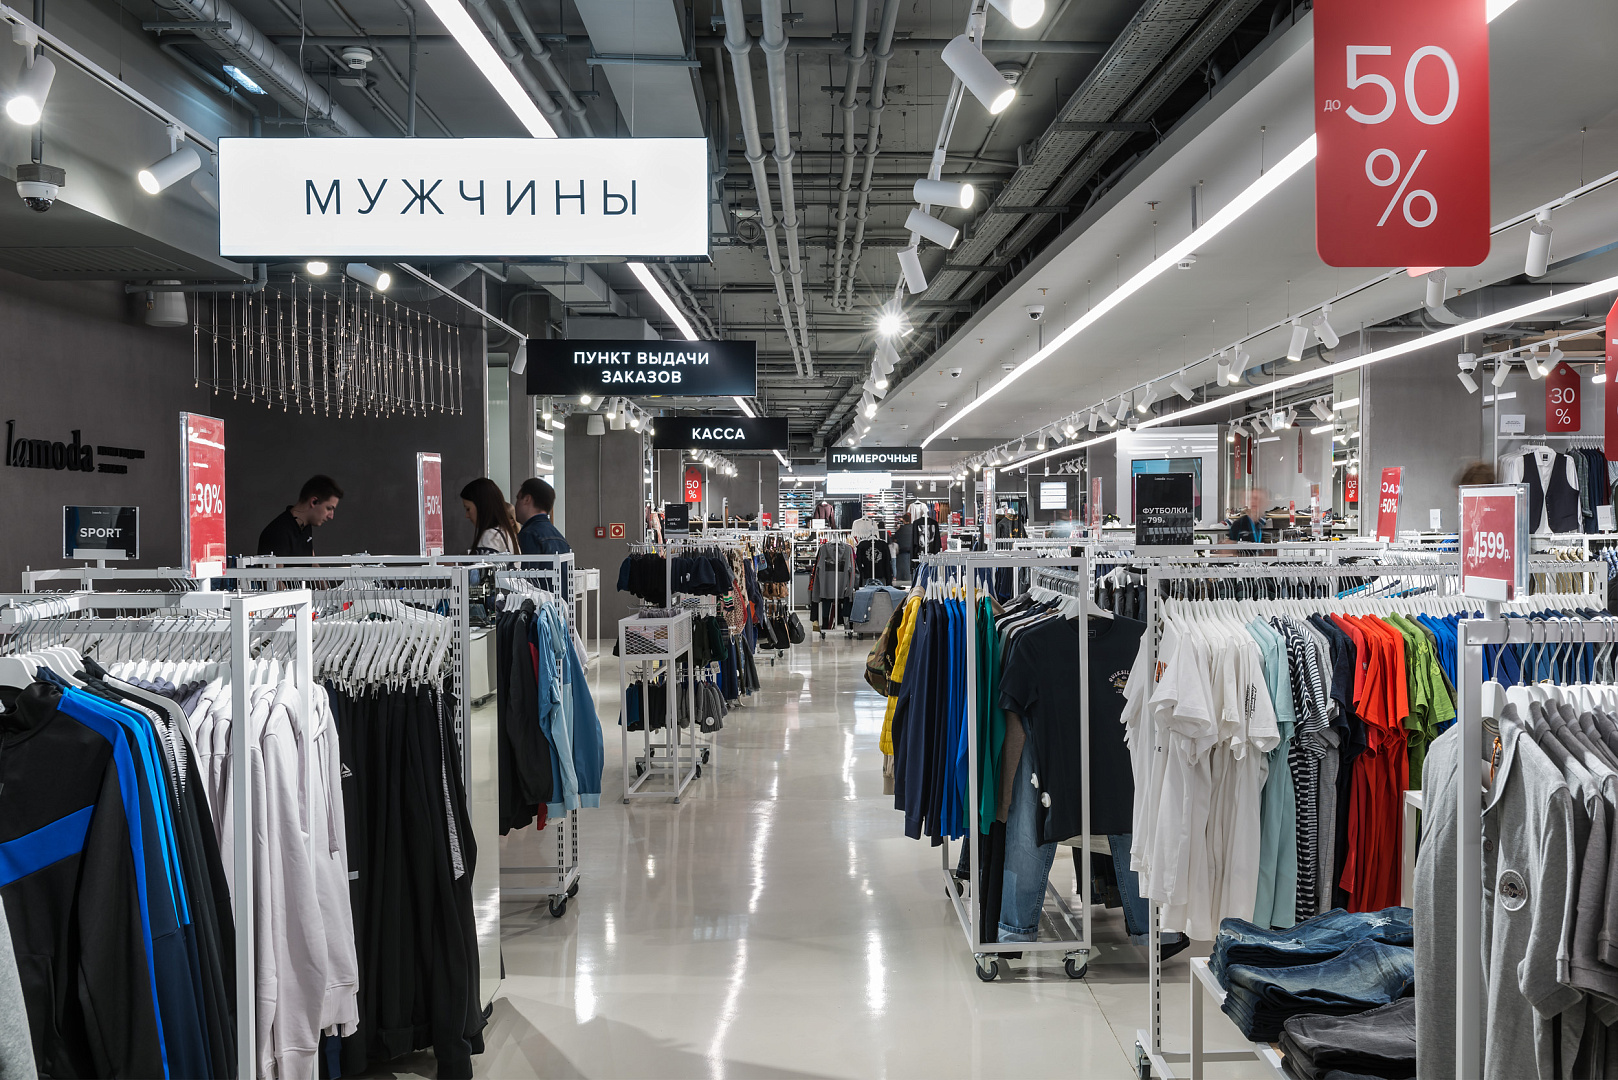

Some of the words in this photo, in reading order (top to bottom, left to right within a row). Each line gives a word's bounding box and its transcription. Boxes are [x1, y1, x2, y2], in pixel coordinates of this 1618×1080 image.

[1345, 45, 1459, 125] 50
[1365, 148, 1438, 228] %
[305, 178, 637, 215] МУЖЧИНЫ
[573, 351, 631, 365] ПУНКТ
[636, 352, 709, 367] ВЫДАЧИ
[601, 370, 682, 384] ЗАКАЗОВ
[1551, 387, 1575, 404] 30
[1555, 408, 1571, 425] %
[692, 428, 745, 440] КАССА
[5, 419, 95, 472] lamoda
[832, 453, 918, 463] ПРИМЕРОЧНЫЕ
[686, 480, 699, 489] 50
[195, 482, 223, 514] 30%
[688, 489, 697, 499] %
[1142, 506, 1188, 514] ФУТБОЛКИ
[1147, 516, 1163, 524] 799
[80, 527, 122, 538] SPORT
[1467, 546, 1475, 558] до
[1474, 531, 1505, 559] 1599
